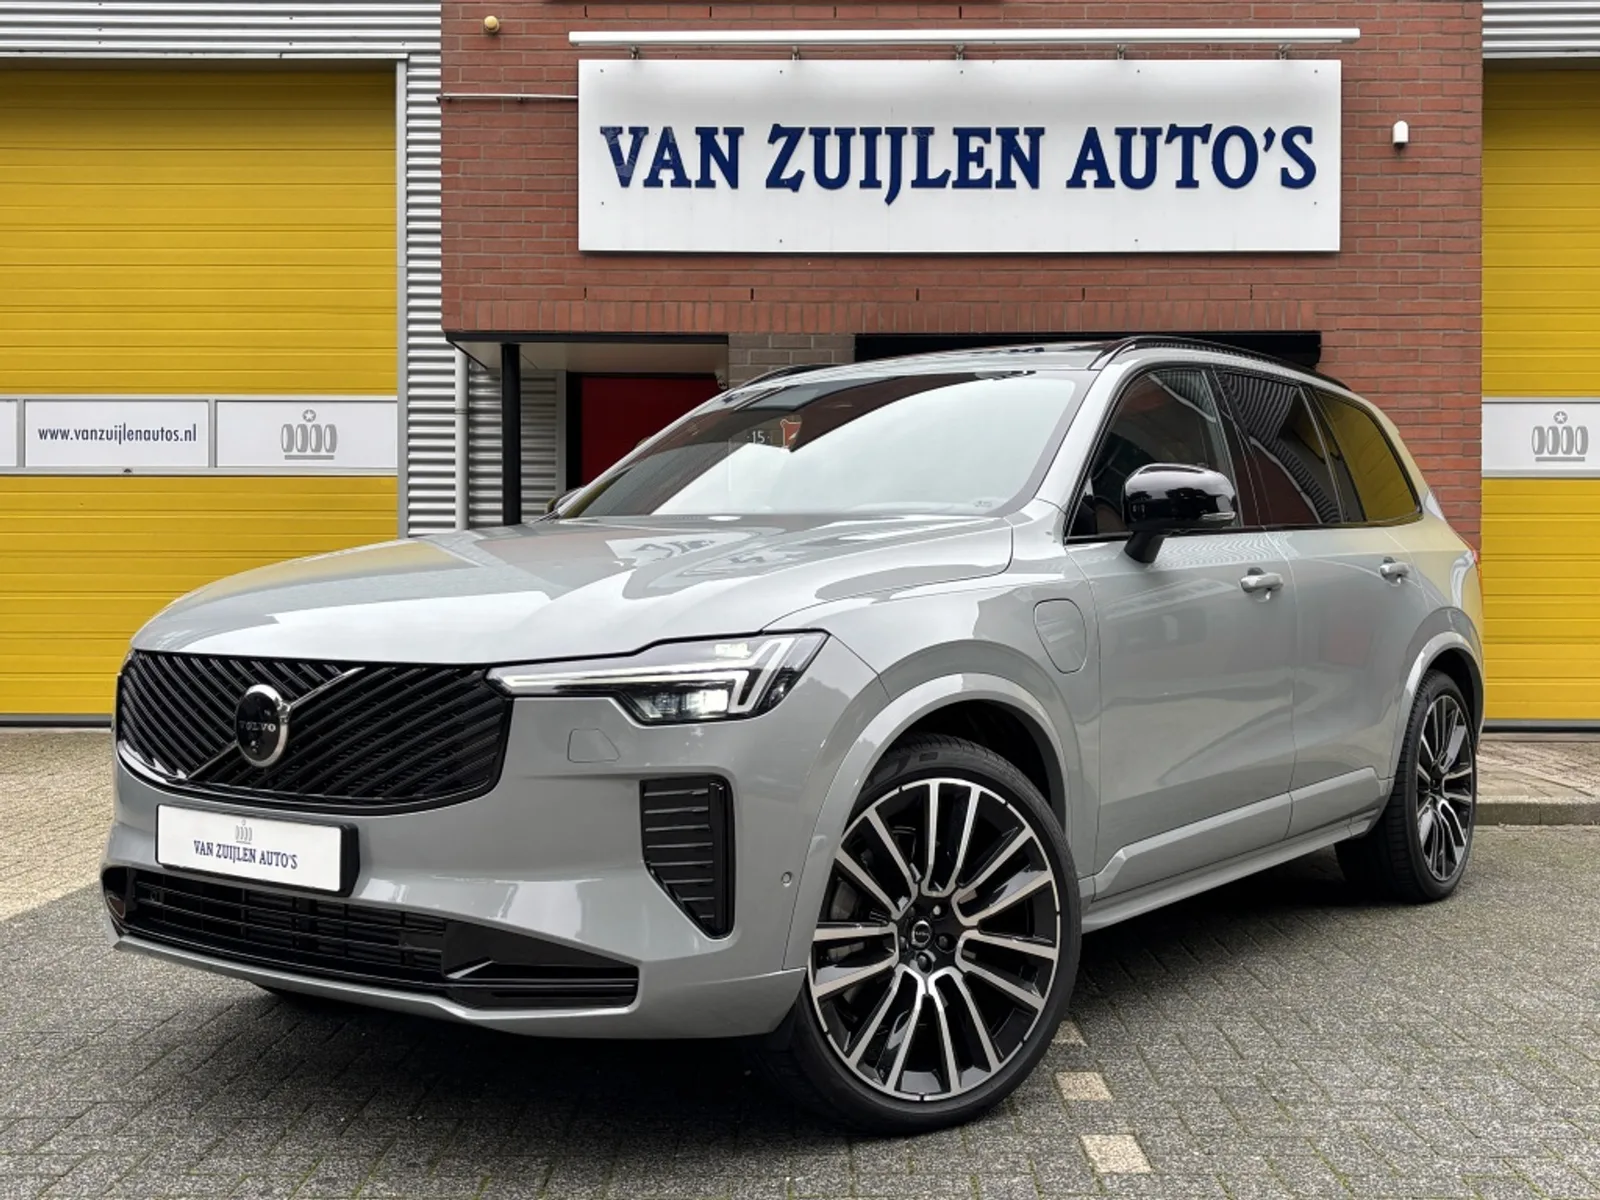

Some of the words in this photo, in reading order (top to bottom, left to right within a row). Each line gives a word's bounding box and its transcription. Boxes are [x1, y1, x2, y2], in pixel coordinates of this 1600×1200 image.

[600, 127, 745, 190] VAN
[766, 124, 1045, 206] ZUIJLEN
[1066, 124, 1317, 190] AUTO'S
[38, 422, 197, 445] www.vanzuijlenautos.nl
[194, 840, 213, 856] VAN
[216, 843, 256, 863] ZUIJLEN
[259, 850, 298, 869] AUTO'S
